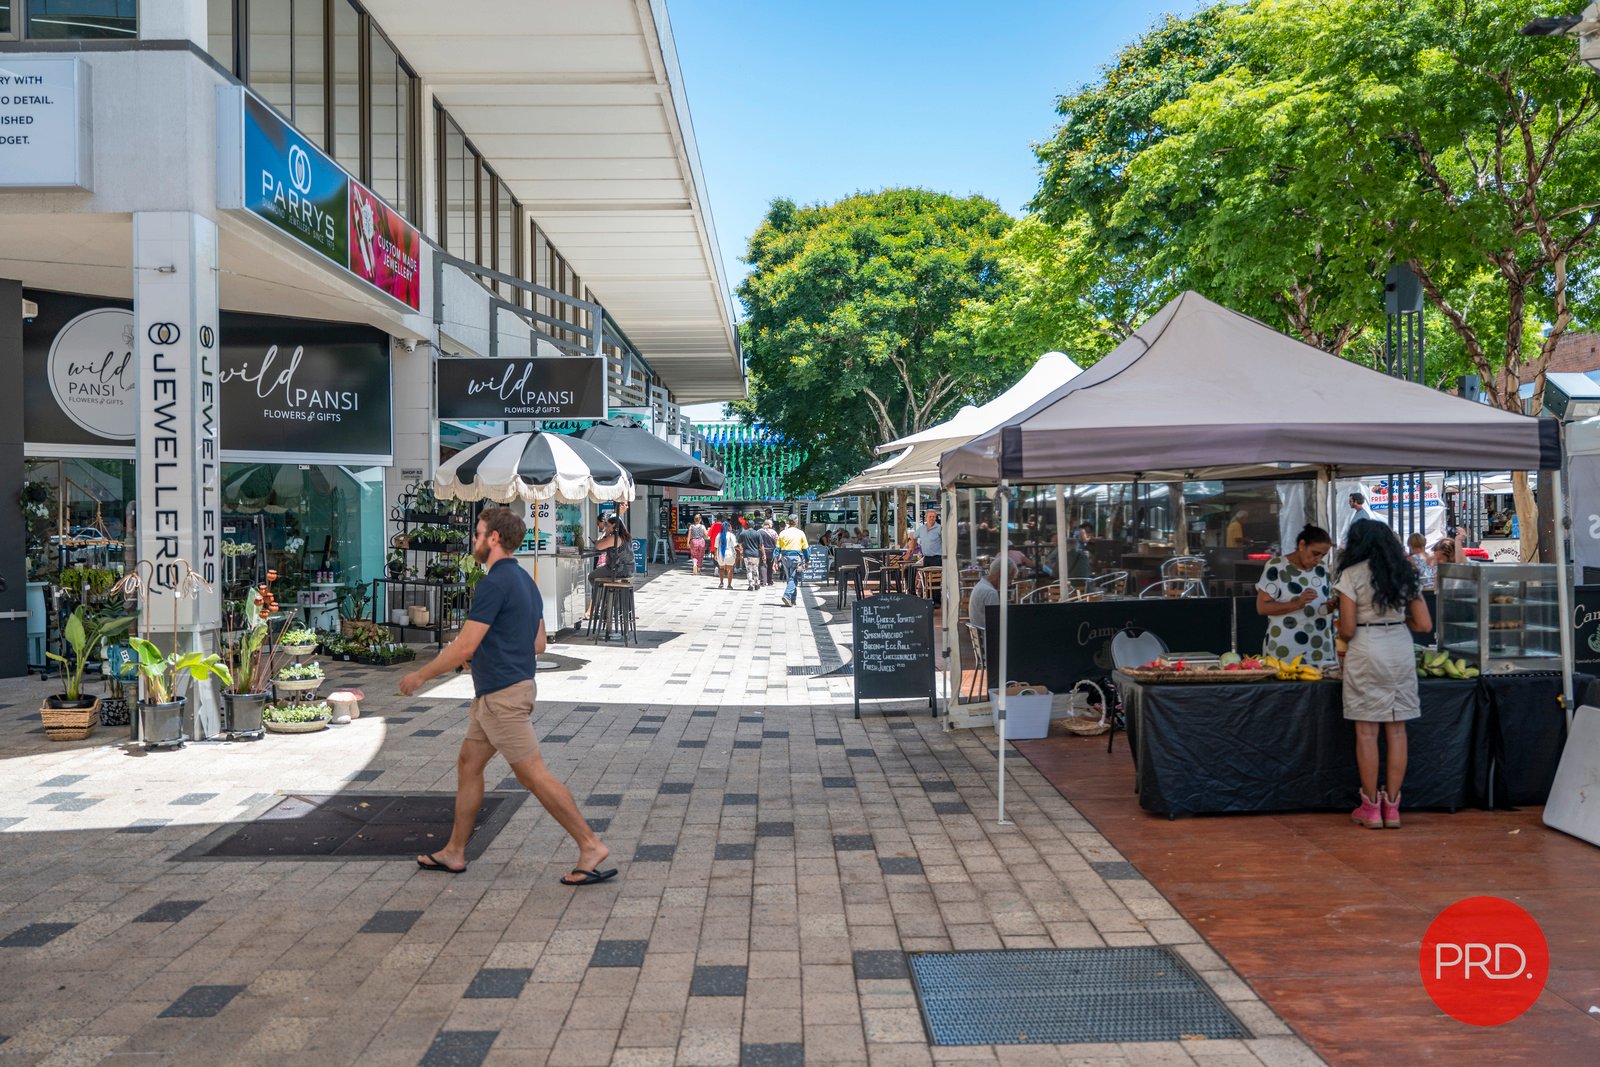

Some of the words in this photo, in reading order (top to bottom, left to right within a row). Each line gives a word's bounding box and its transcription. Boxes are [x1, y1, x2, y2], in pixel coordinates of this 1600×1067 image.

[14, 76, 43, 84] WITH
[0, 96, 10, 104] O
[14, 96, 54, 104] DETAIL.
[1, 116, 34, 124] ISHED
[0, 136, 30, 144] DGET.
[262, 169, 335, 240] PARRYS
[378, 235, 401, 262] CUSTOM
[402, 252, 417, 272] MADE
[384, 254, 413, 282] JEWELLERY
[68, 351, 132, 390] wild
[69, 382, 115, 396] PANSI
[468, 362, 534, 405] wild
[68, 396, 98, 404] FLOWERS
[296, 388, 358, 411] PANSI
[526, 391, 574, 405] PANSI
[264, 409, 306, 420] FLOWERS
[317, 412, 342, 422] GIFTS
[153, 353, 179, 586] JEWELLERS
[201, 356, 214, 584] JEWELLERS
[863, 606, 879, 615] BLT
